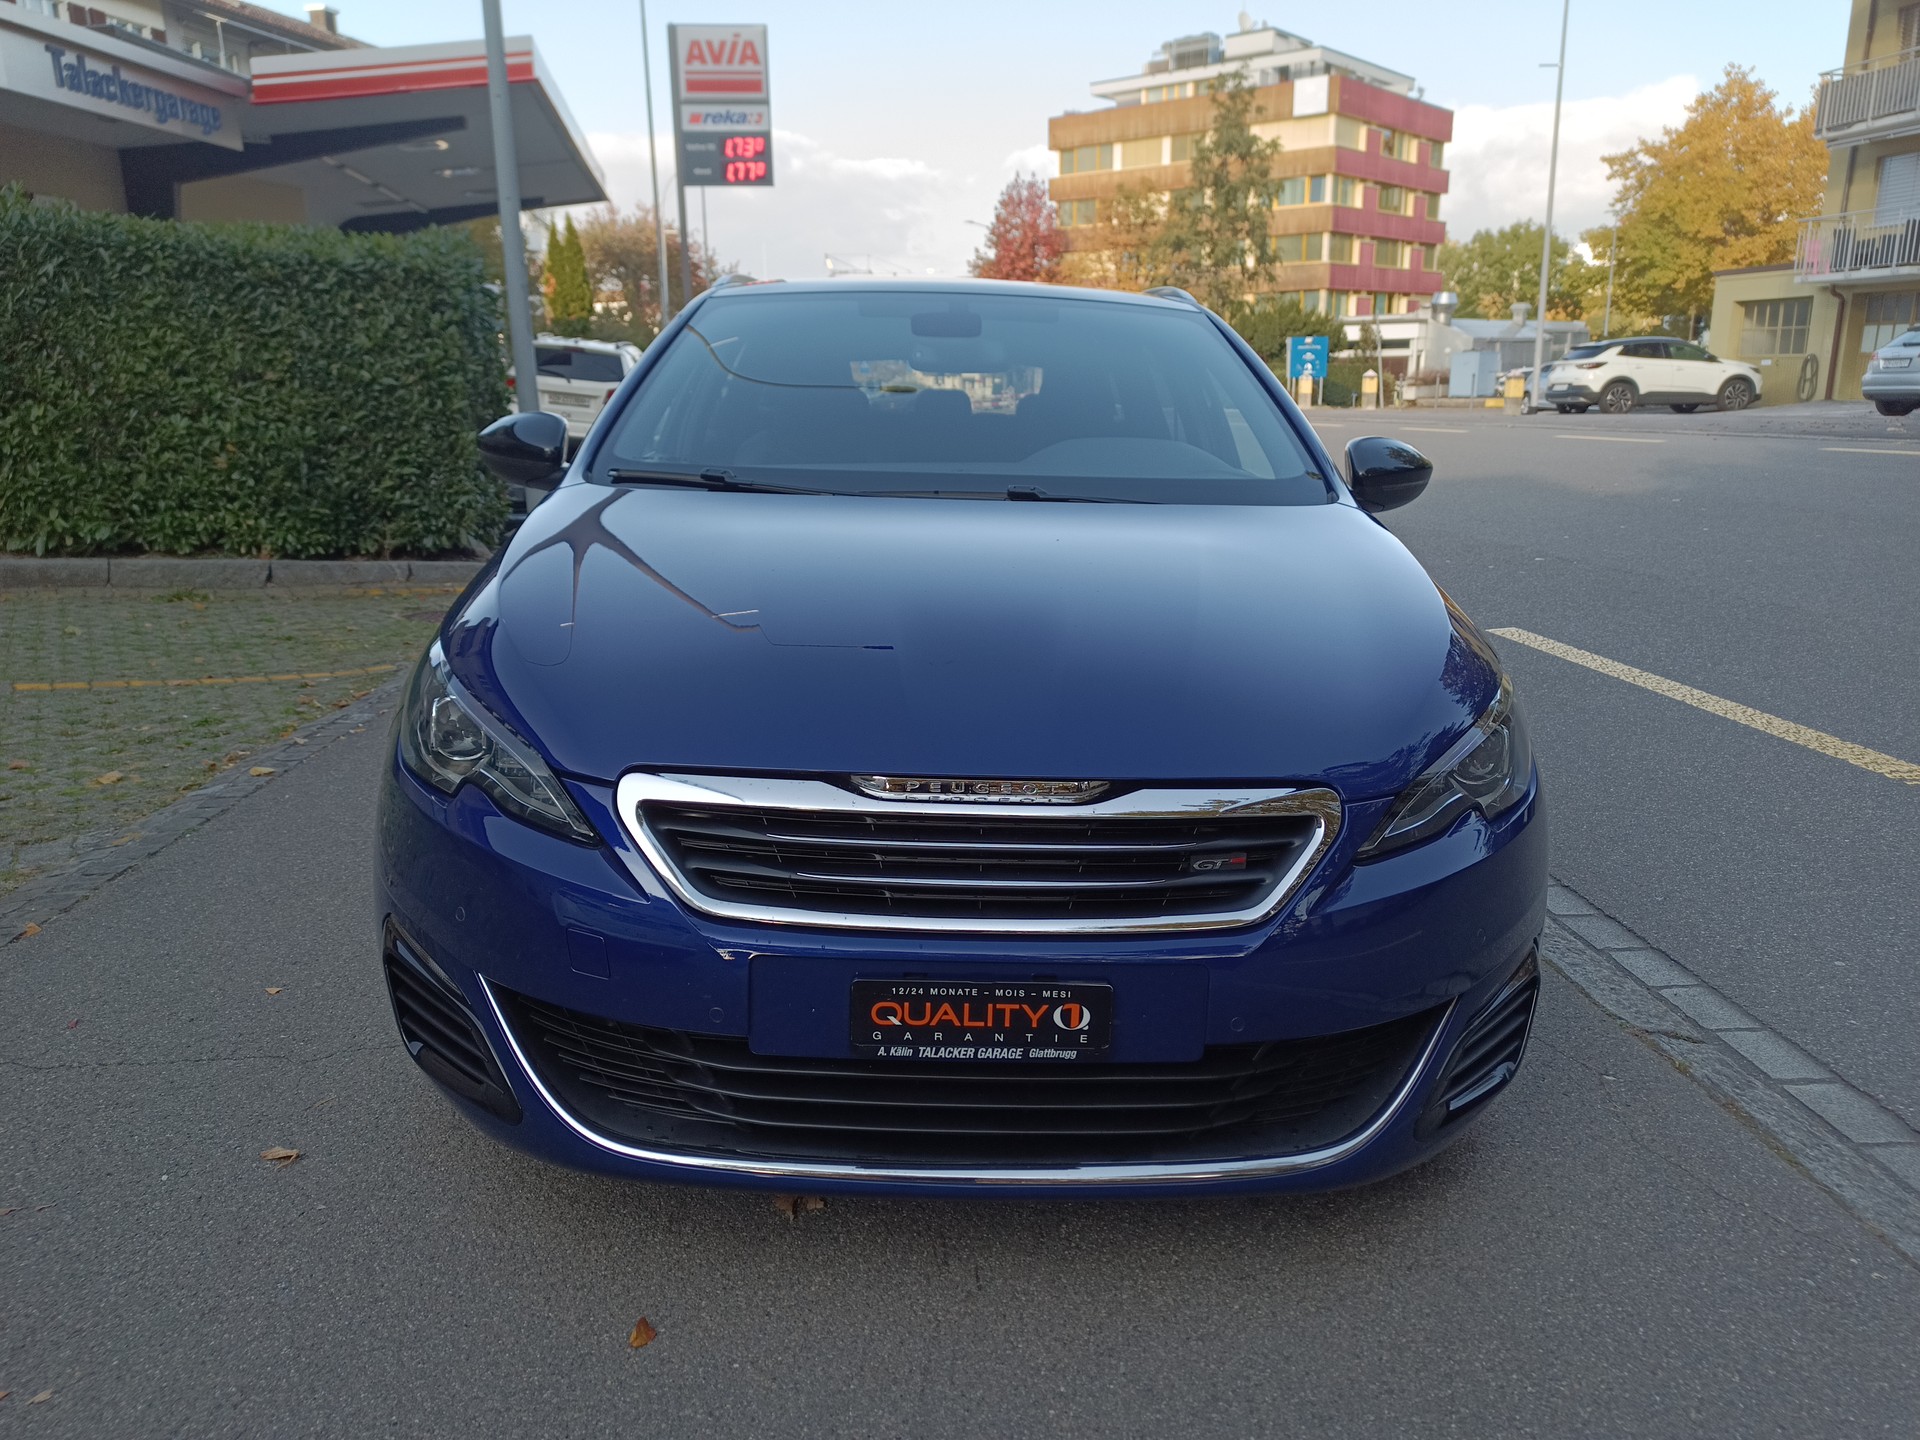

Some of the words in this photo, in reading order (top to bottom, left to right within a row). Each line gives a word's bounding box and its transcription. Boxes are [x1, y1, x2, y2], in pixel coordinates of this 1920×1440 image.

[44, 43, 221, 134] Talackergarage
[702, 109, 748, 125] reka
[905, 780, 1059, 795] PEUGEOT
[1193, 858, 1229, 870] GT
[891, 987, 924, 995] 12/24
[930, 988, 978, 996] MONATE
[995, 989, 1026, 998] MOIS
[1042, 990, 1071, 998] MESI
[870, 1001, 1049, 1028] QUALITY
[872, 1031, 1088, 1043] GARANTIE
[877, 1046, 887, 1056] A.
[889, 1046, 913, 1057] Kälin
[918, 1046, 975, 1059] TALACKER
[977, 1047, 1024, 1059] GARAGE
[1028, 1048, 1077, 1060] Glattbrugg
